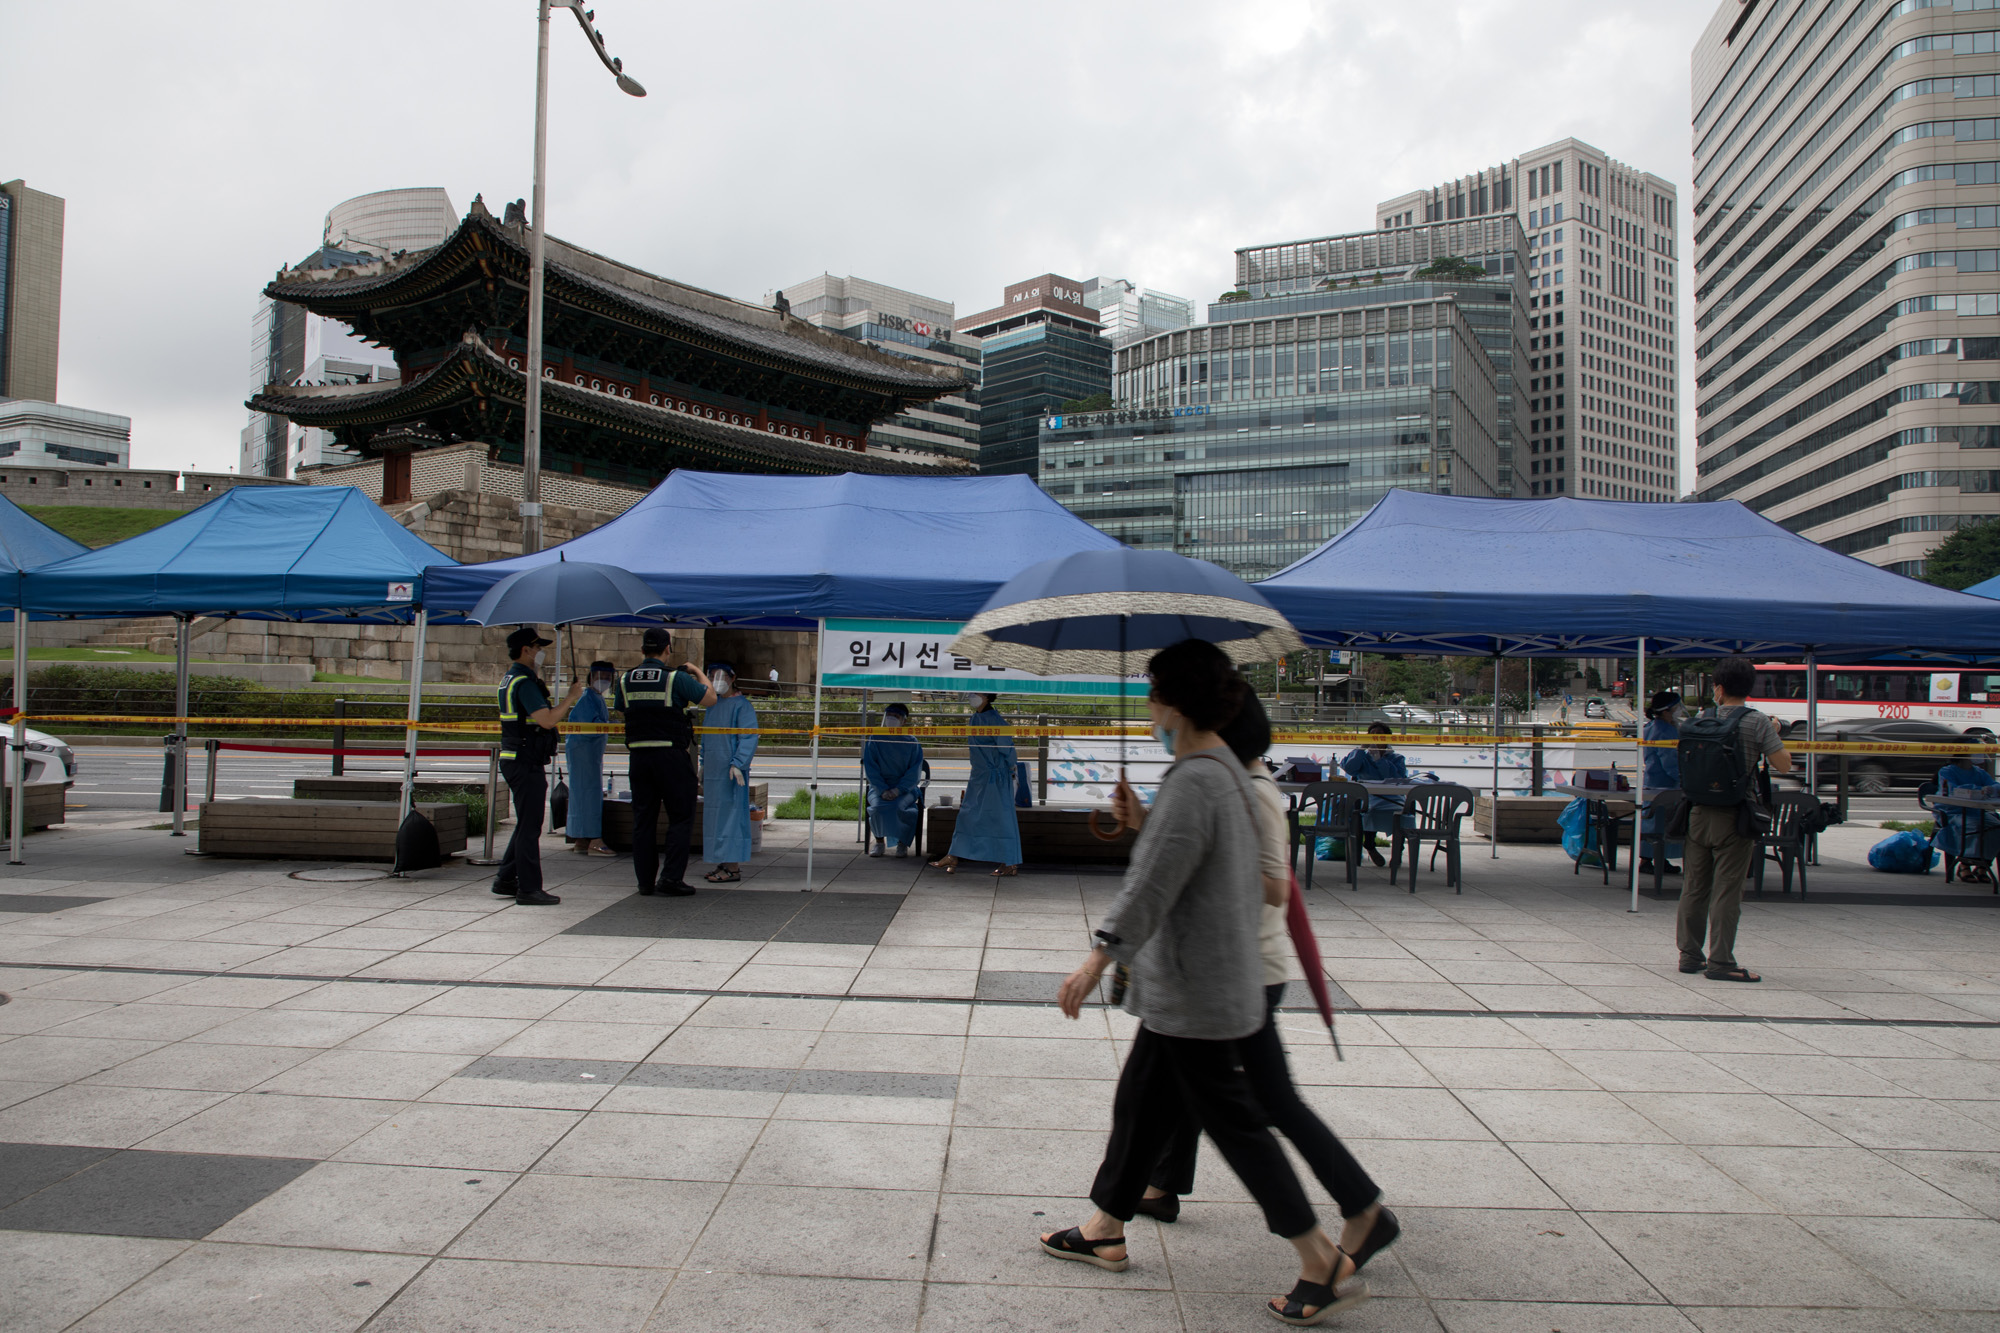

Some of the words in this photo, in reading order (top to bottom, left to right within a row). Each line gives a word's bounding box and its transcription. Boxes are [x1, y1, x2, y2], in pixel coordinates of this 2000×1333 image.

[878, 312, 912, 332] HSBC
[1174, 405, 1210, 417] KCCI
[1878, 704, 1909, 719] 9200
